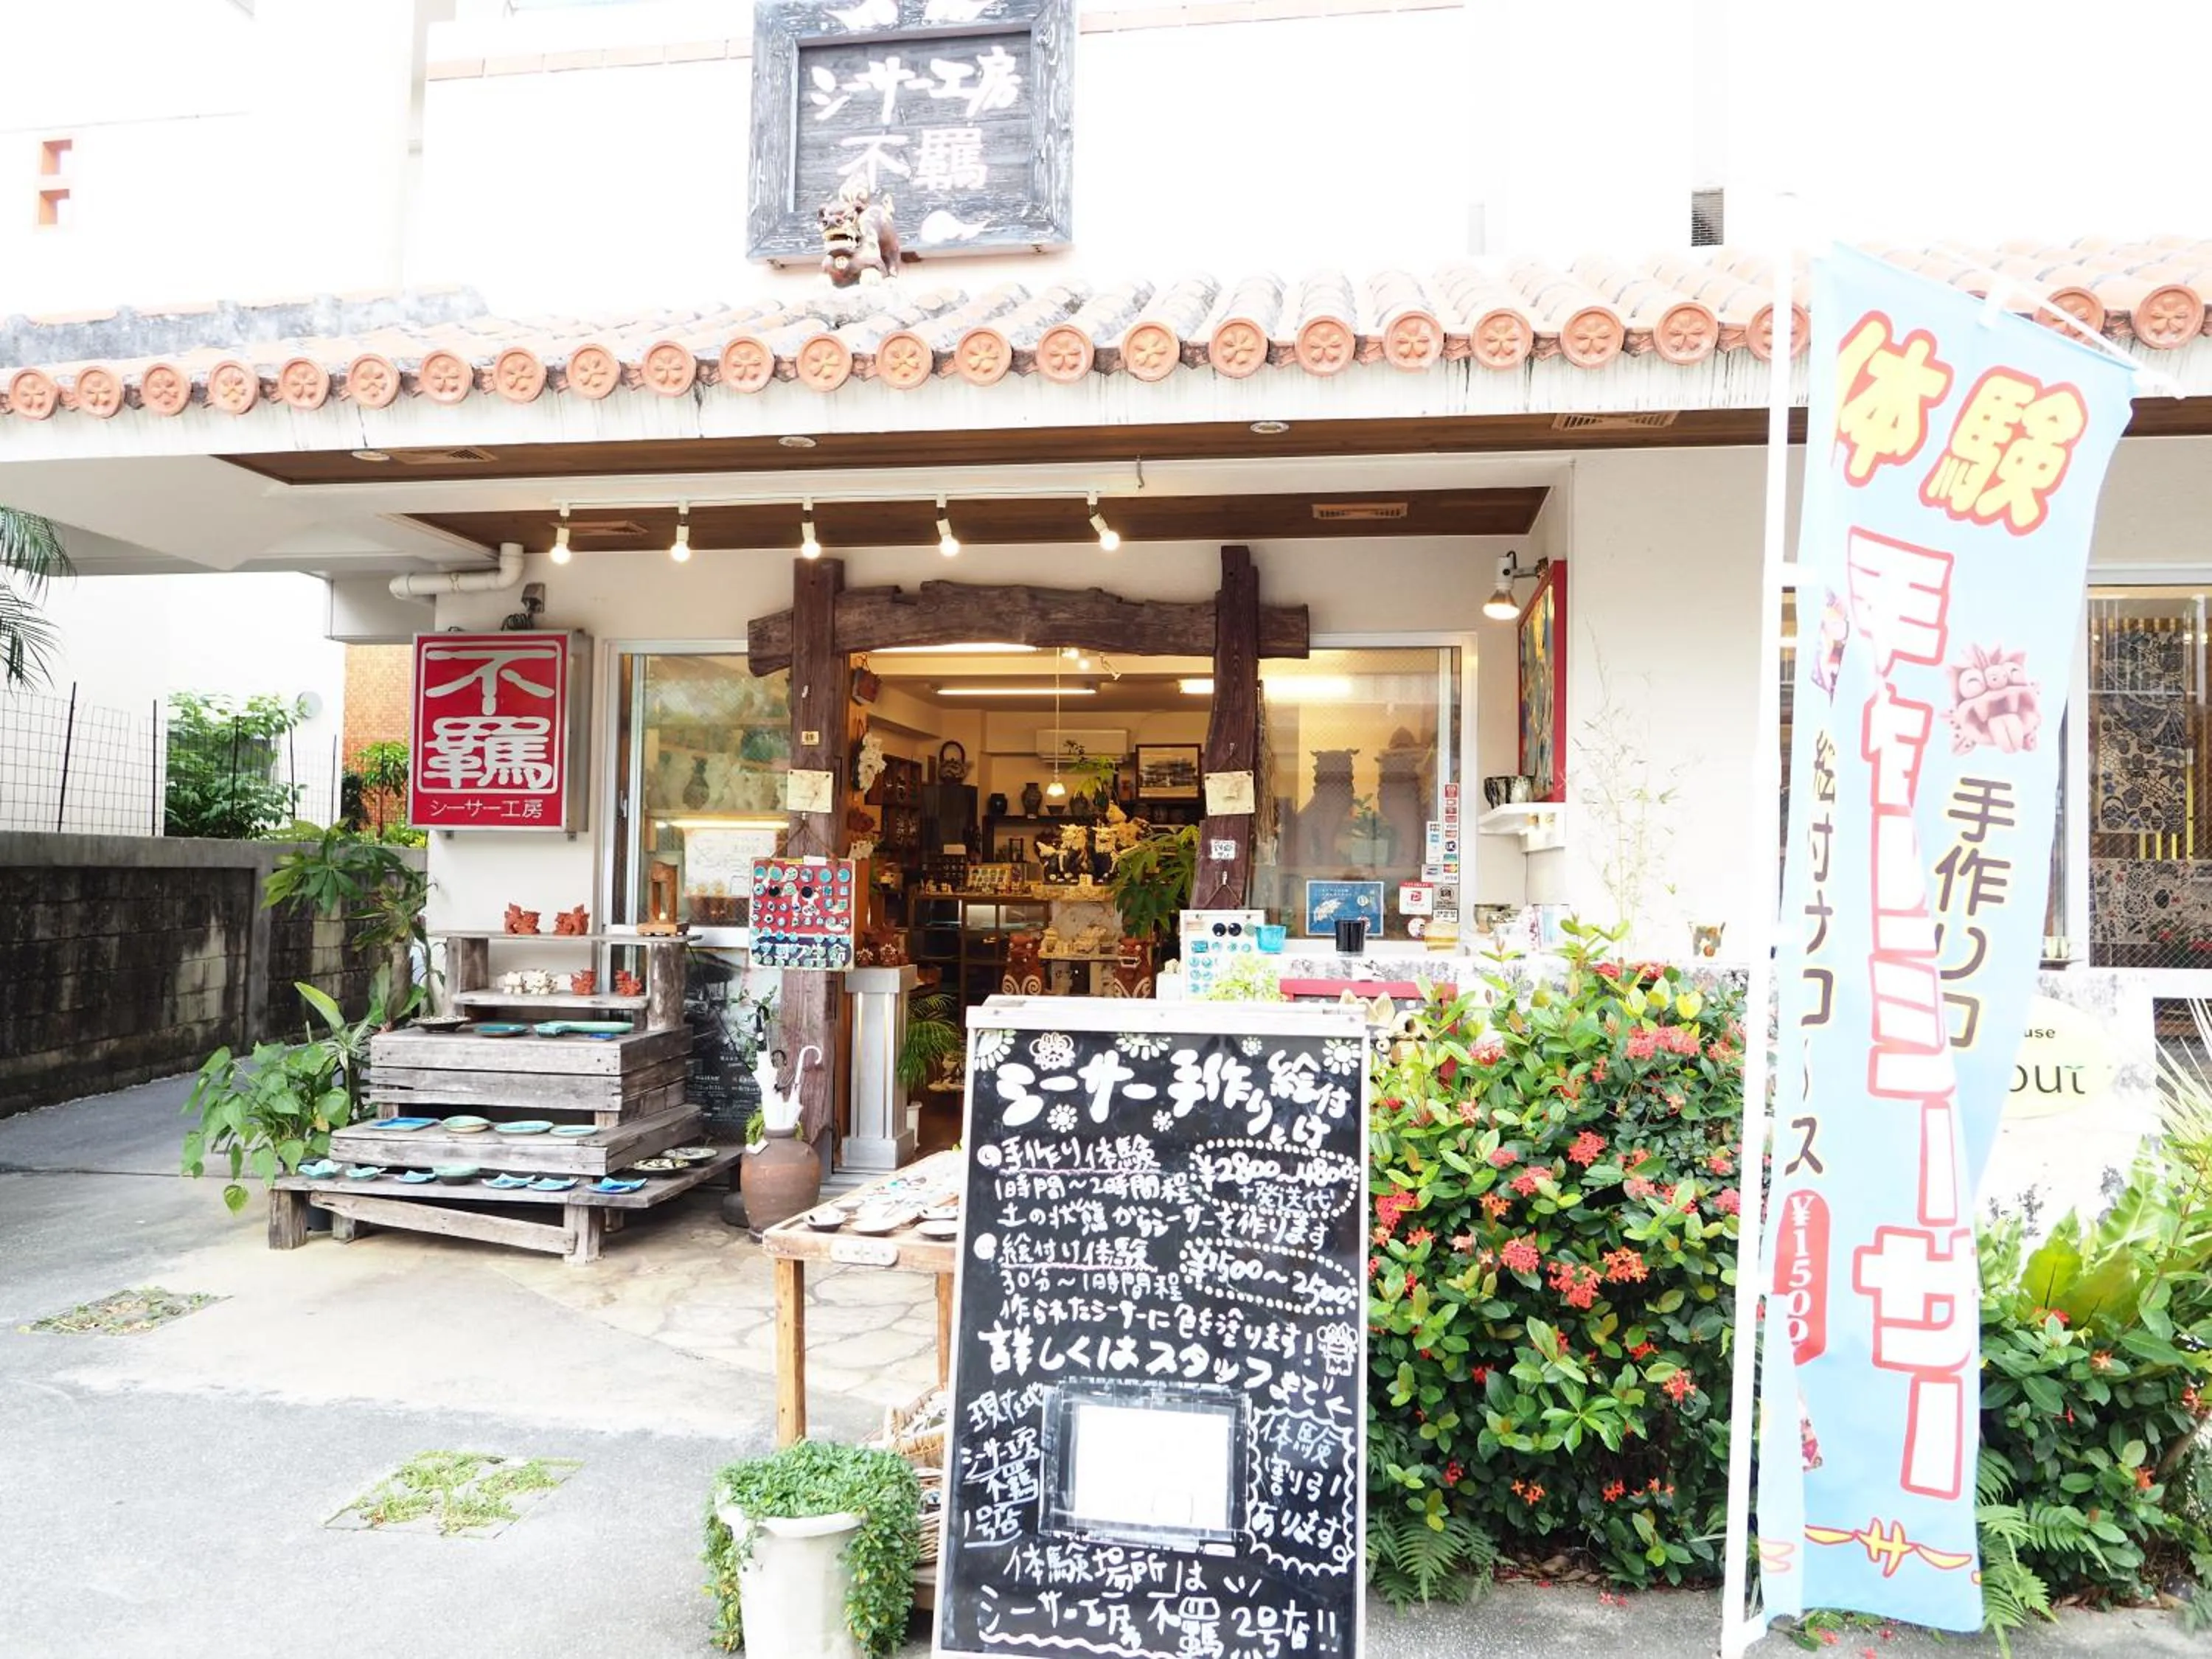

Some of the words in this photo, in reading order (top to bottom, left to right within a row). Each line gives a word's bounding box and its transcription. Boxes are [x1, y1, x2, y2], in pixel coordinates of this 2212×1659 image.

[810, 45, 1022, 125] シーサー工房
[1836, 310, 2089, 537] 体験
[424, 650, 555, 789] 不羈
[428, 799, 543, 819] シーサー工房
[1001, 1134, 1161, 1169] 手作り体験
[967, 1381, 1044, 1432] 現在地
[960, 1425, 1040, 1480] シーサー工房
[1260, 1416, 1343, 1469] 体験
[1004, 1541, 1207, 1591] 体験場所は
